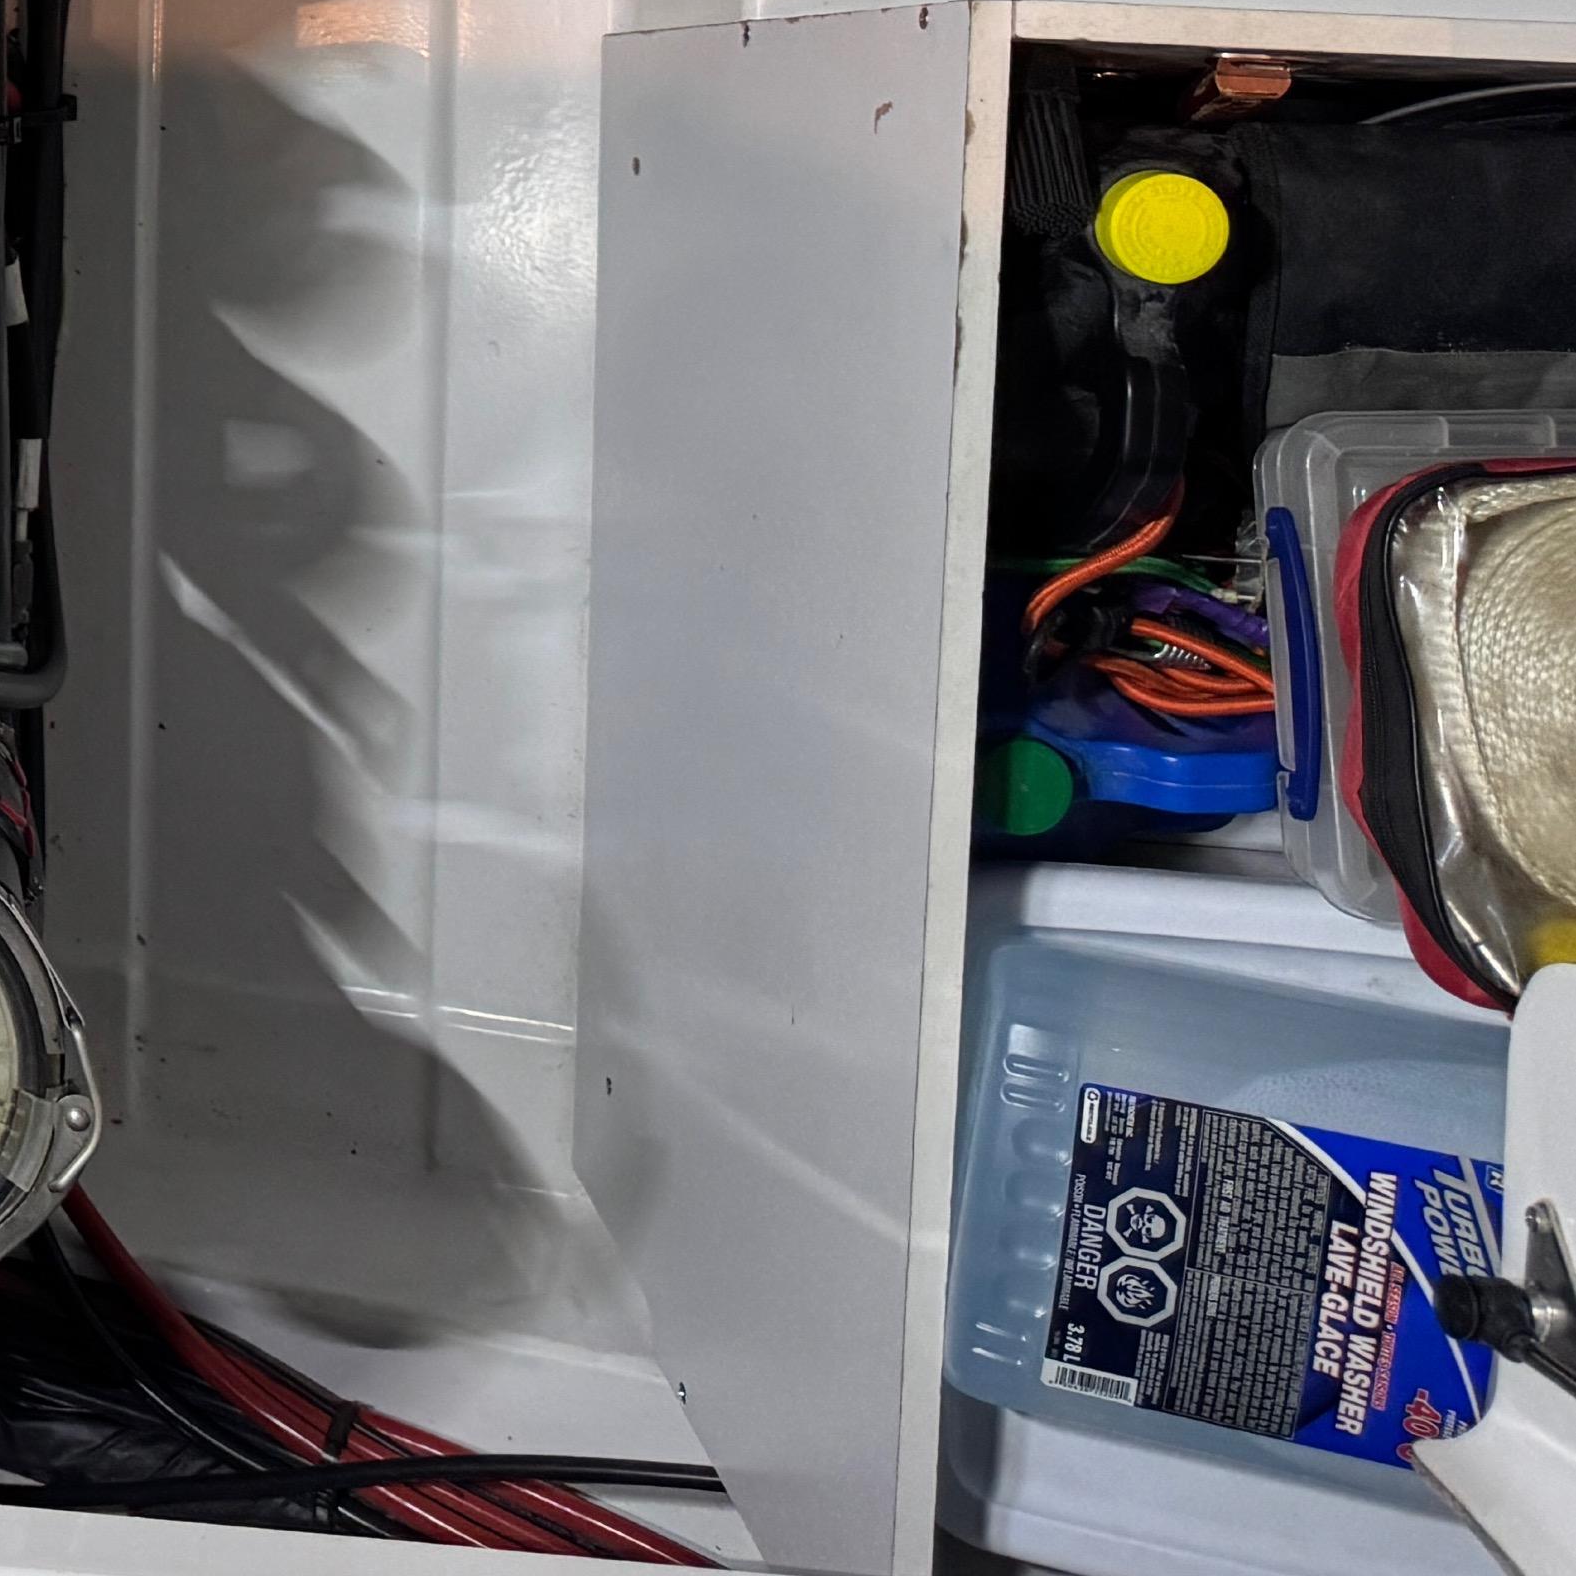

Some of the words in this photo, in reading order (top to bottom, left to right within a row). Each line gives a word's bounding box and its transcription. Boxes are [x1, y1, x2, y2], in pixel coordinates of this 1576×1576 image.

[1071, 1173, 1087, 1204] POISON
[1413, 1179, 1463, 1278] POWE
[1073, 1203, 1107, 1291] DANGER
[1350, 1171, 1398, 1329] WINDSHIELD
[1064, 1322, 1085, 1355] 3.78
[1312, 1219, 1359, 1379] LAVE-GLACE
[1384, 1284, 1402, 1324] SEASON
[1062, 1354, 1080, 1363] L
[1334, 1333, 1381, 1436] WASHER
